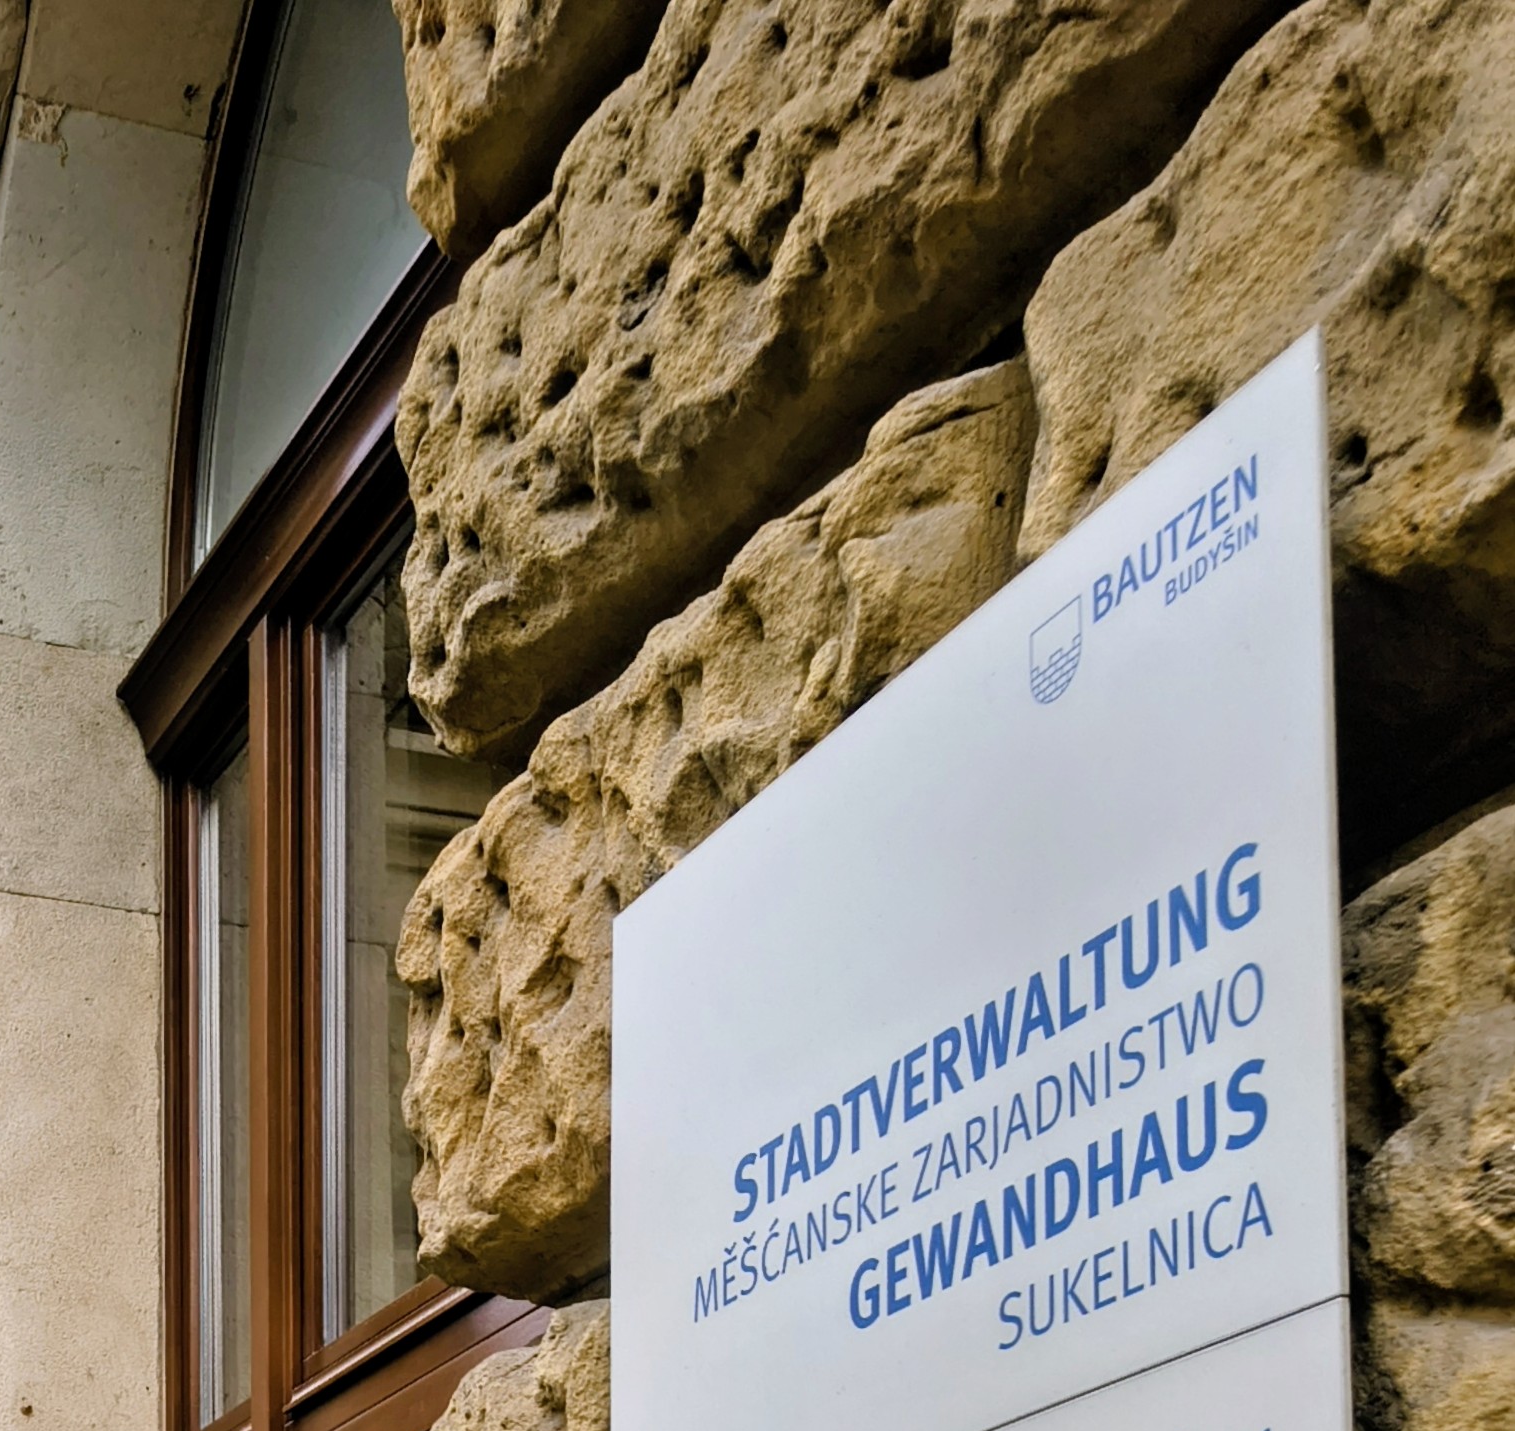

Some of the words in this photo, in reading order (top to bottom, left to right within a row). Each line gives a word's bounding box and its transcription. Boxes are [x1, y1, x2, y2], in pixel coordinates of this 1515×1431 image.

[1092, 454, 1258, 624] BAUTZEN
[1165, 515, 1258, 606] BUDYŠIN
[693, 1162, 900, 1323] MĚŠĆANSKE
[911, 962, 1265, 1203] ZARJADNISTWO
[733, 843, 1262, 1222] STADTVERWALTUNG
[849, 1059, 1269, 1330] GEWANDHAUS
[998, 1182, 1274, 1351] SUKELNICA
